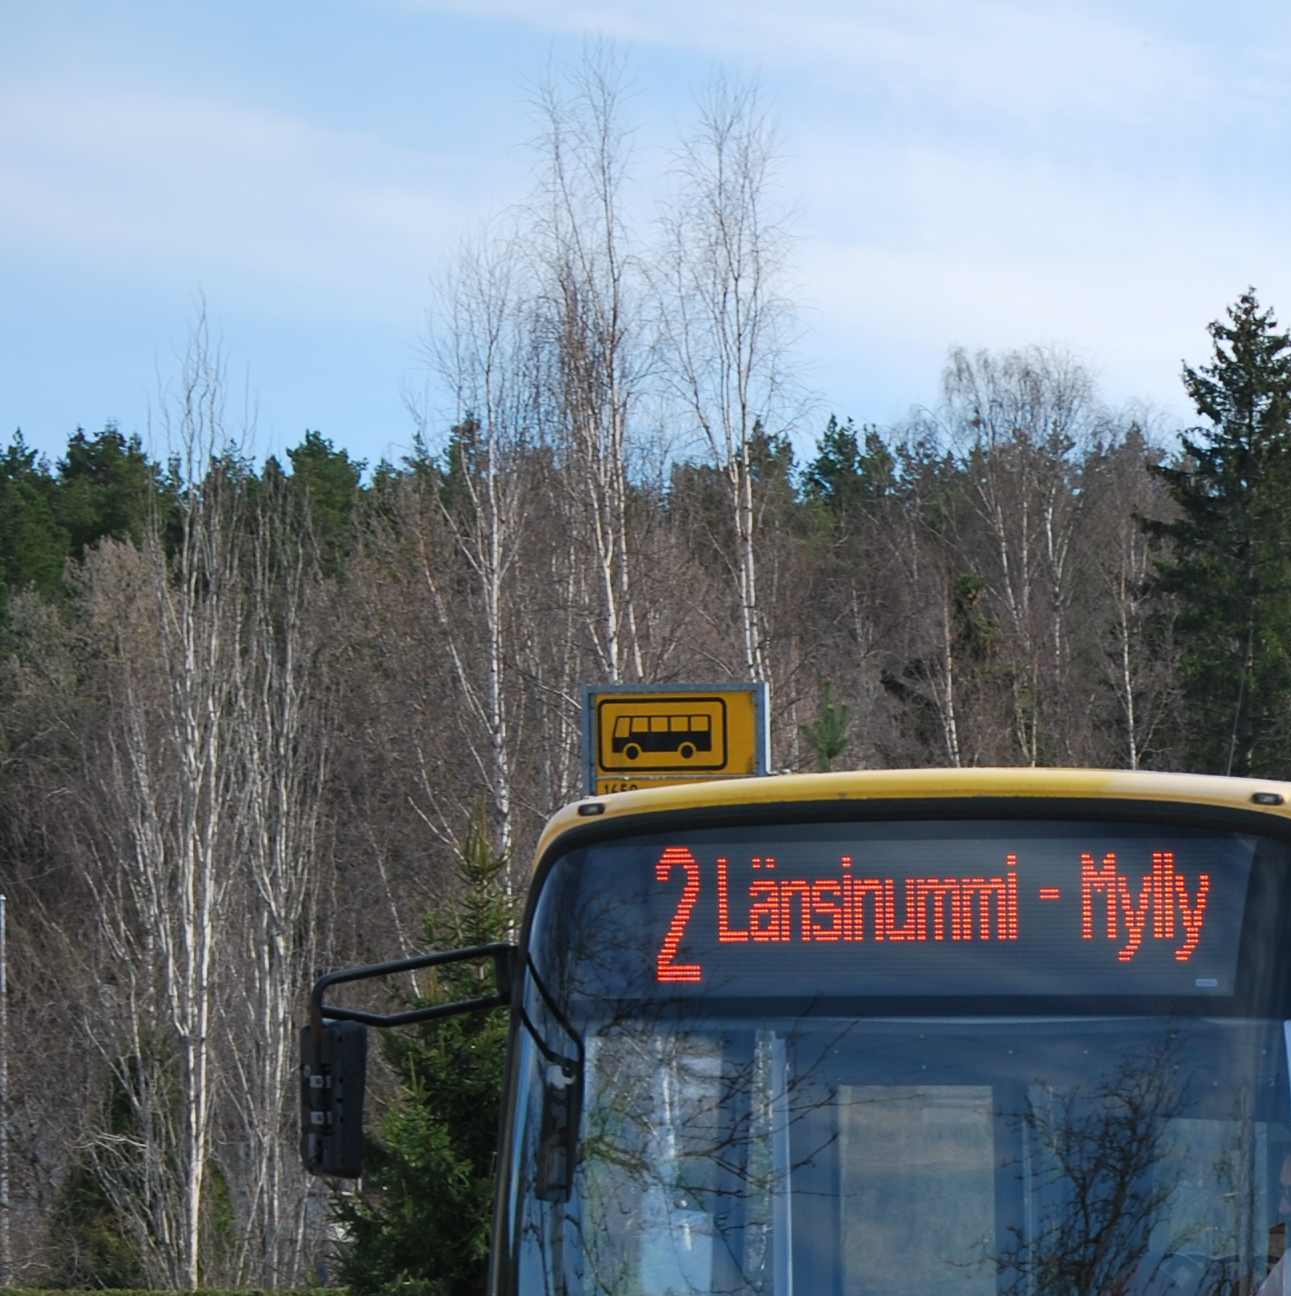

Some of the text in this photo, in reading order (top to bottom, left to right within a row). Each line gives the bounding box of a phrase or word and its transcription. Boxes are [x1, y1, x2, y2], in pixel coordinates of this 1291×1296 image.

[655, 847, 701, 982] 2
[717, 855, 1018, 942] Länsinummi
[1081, 851, 1210, 961] Mylly
